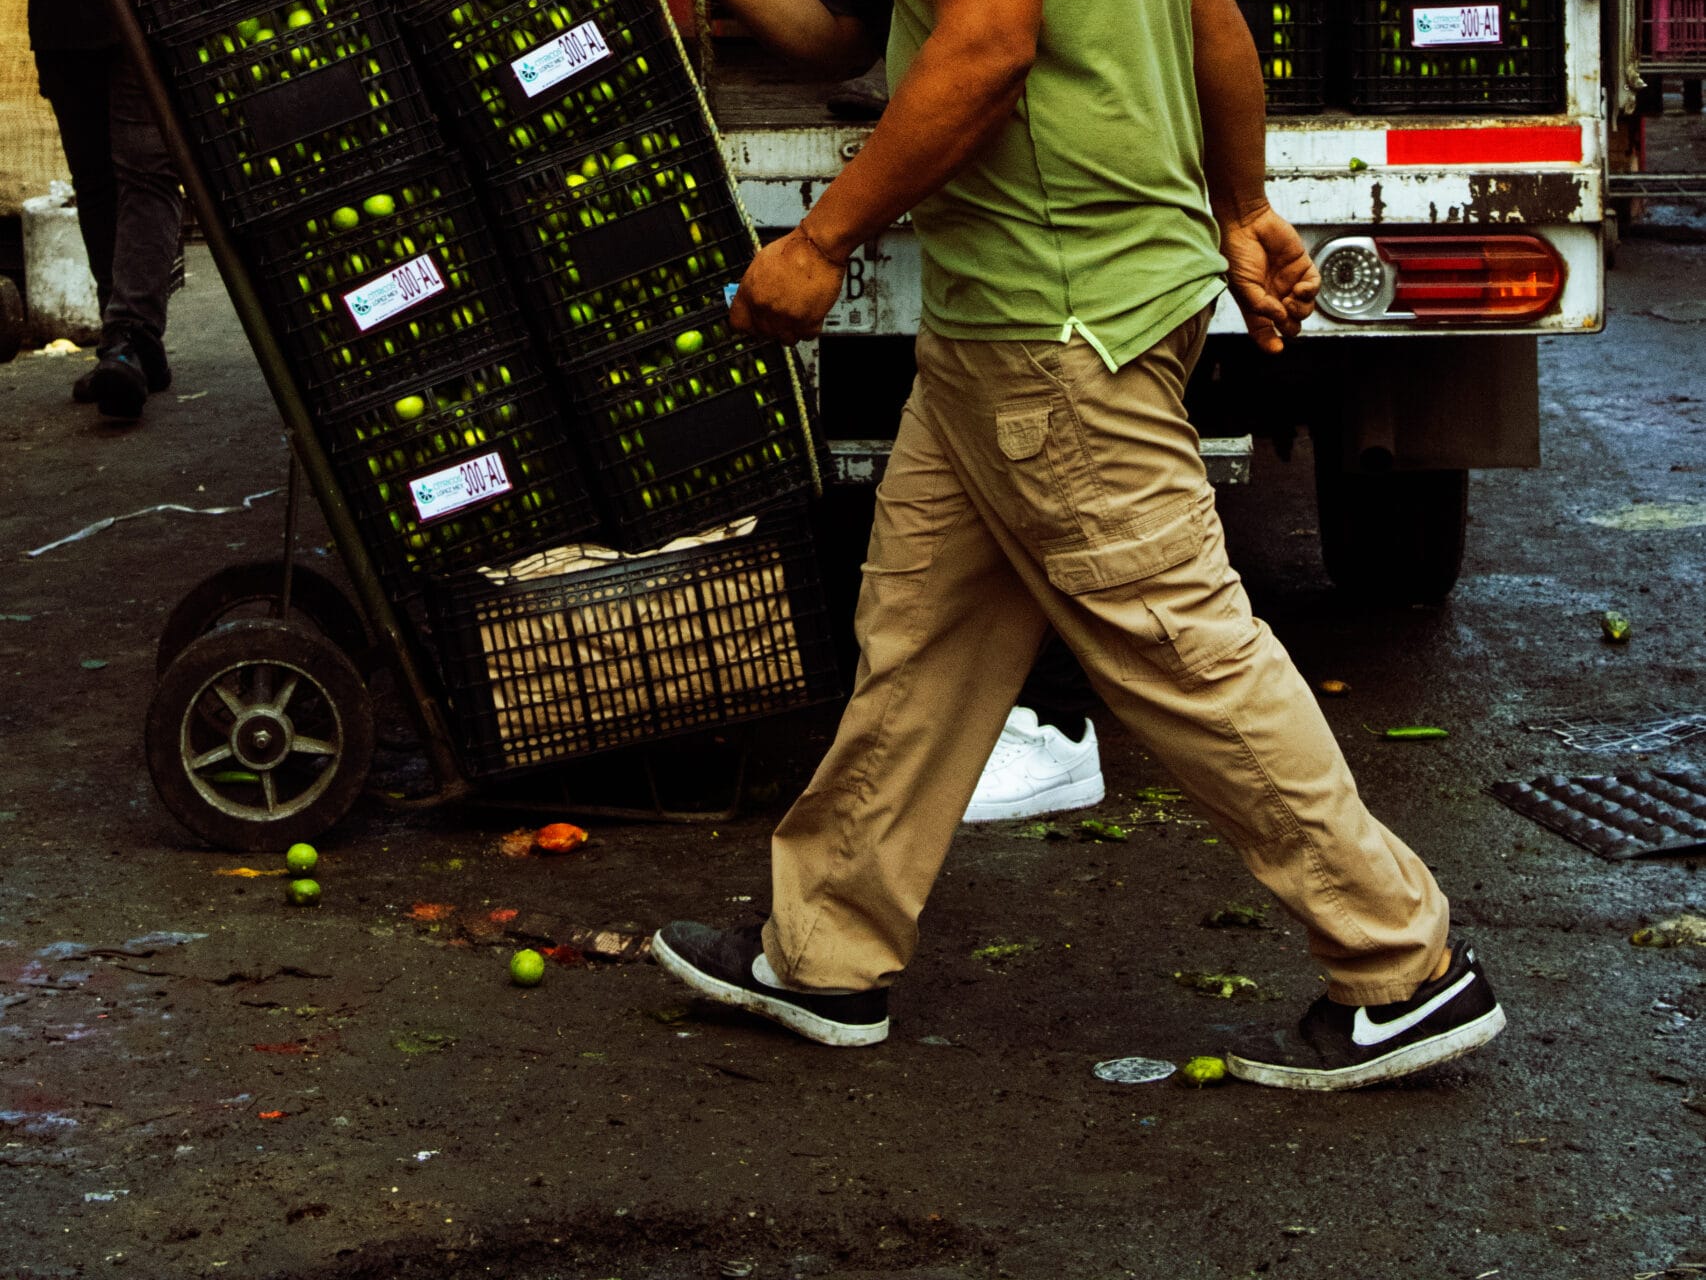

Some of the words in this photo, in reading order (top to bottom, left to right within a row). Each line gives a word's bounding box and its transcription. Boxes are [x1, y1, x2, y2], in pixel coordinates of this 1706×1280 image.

[1461, 8, 1498, 37] 300-AL
[558, 23, 606, 67] 300-AL
[392, 257, 440, 301] 300-AL
[460, 455, 506, 496] 300-AL
